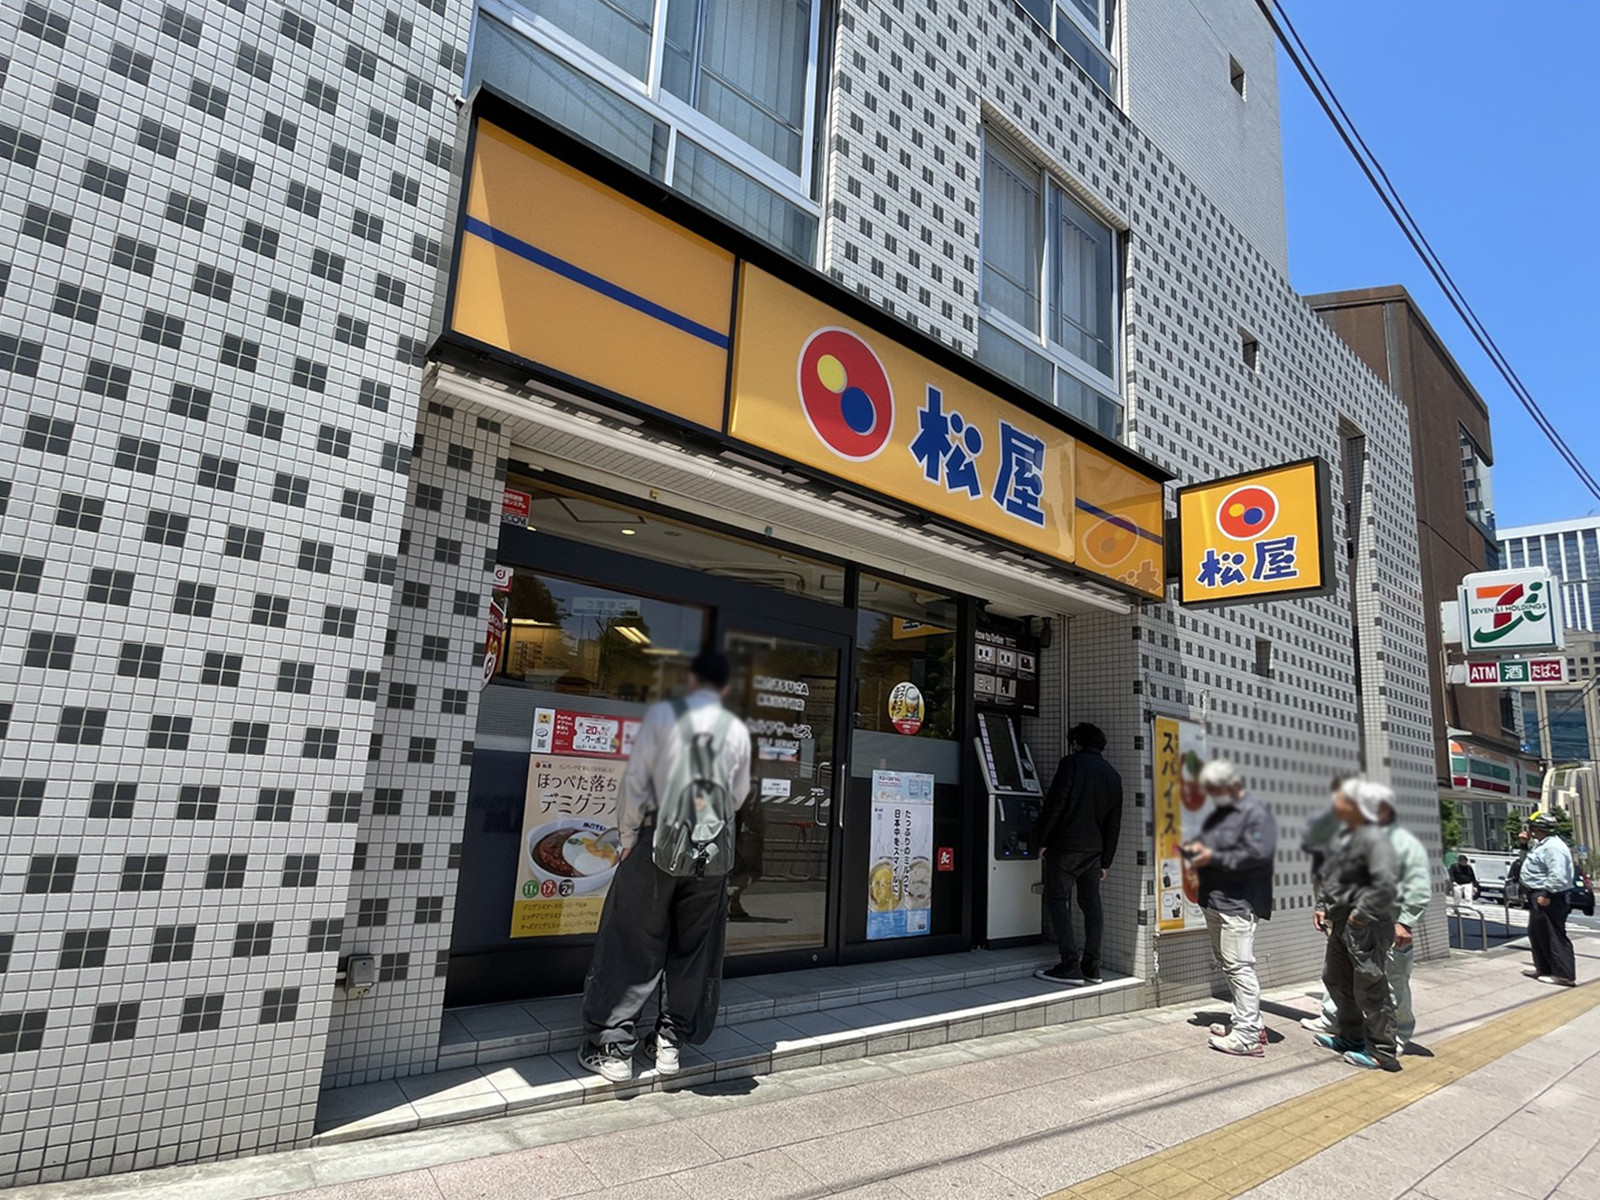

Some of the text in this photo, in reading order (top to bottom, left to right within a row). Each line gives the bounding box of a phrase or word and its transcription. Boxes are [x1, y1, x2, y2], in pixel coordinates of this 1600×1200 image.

[910, 384, 1046, 528] 松屋
[1197, 536, 1300, 588] 松屋
[1505, 603, 1547, 612] HOLDINGS
[1471, 663, 1560, 680] ATM 酒 たばこ
[538, 773, 617, 792] ほっぺた落ち
[1161, 732, 1176, 836] スパイス
